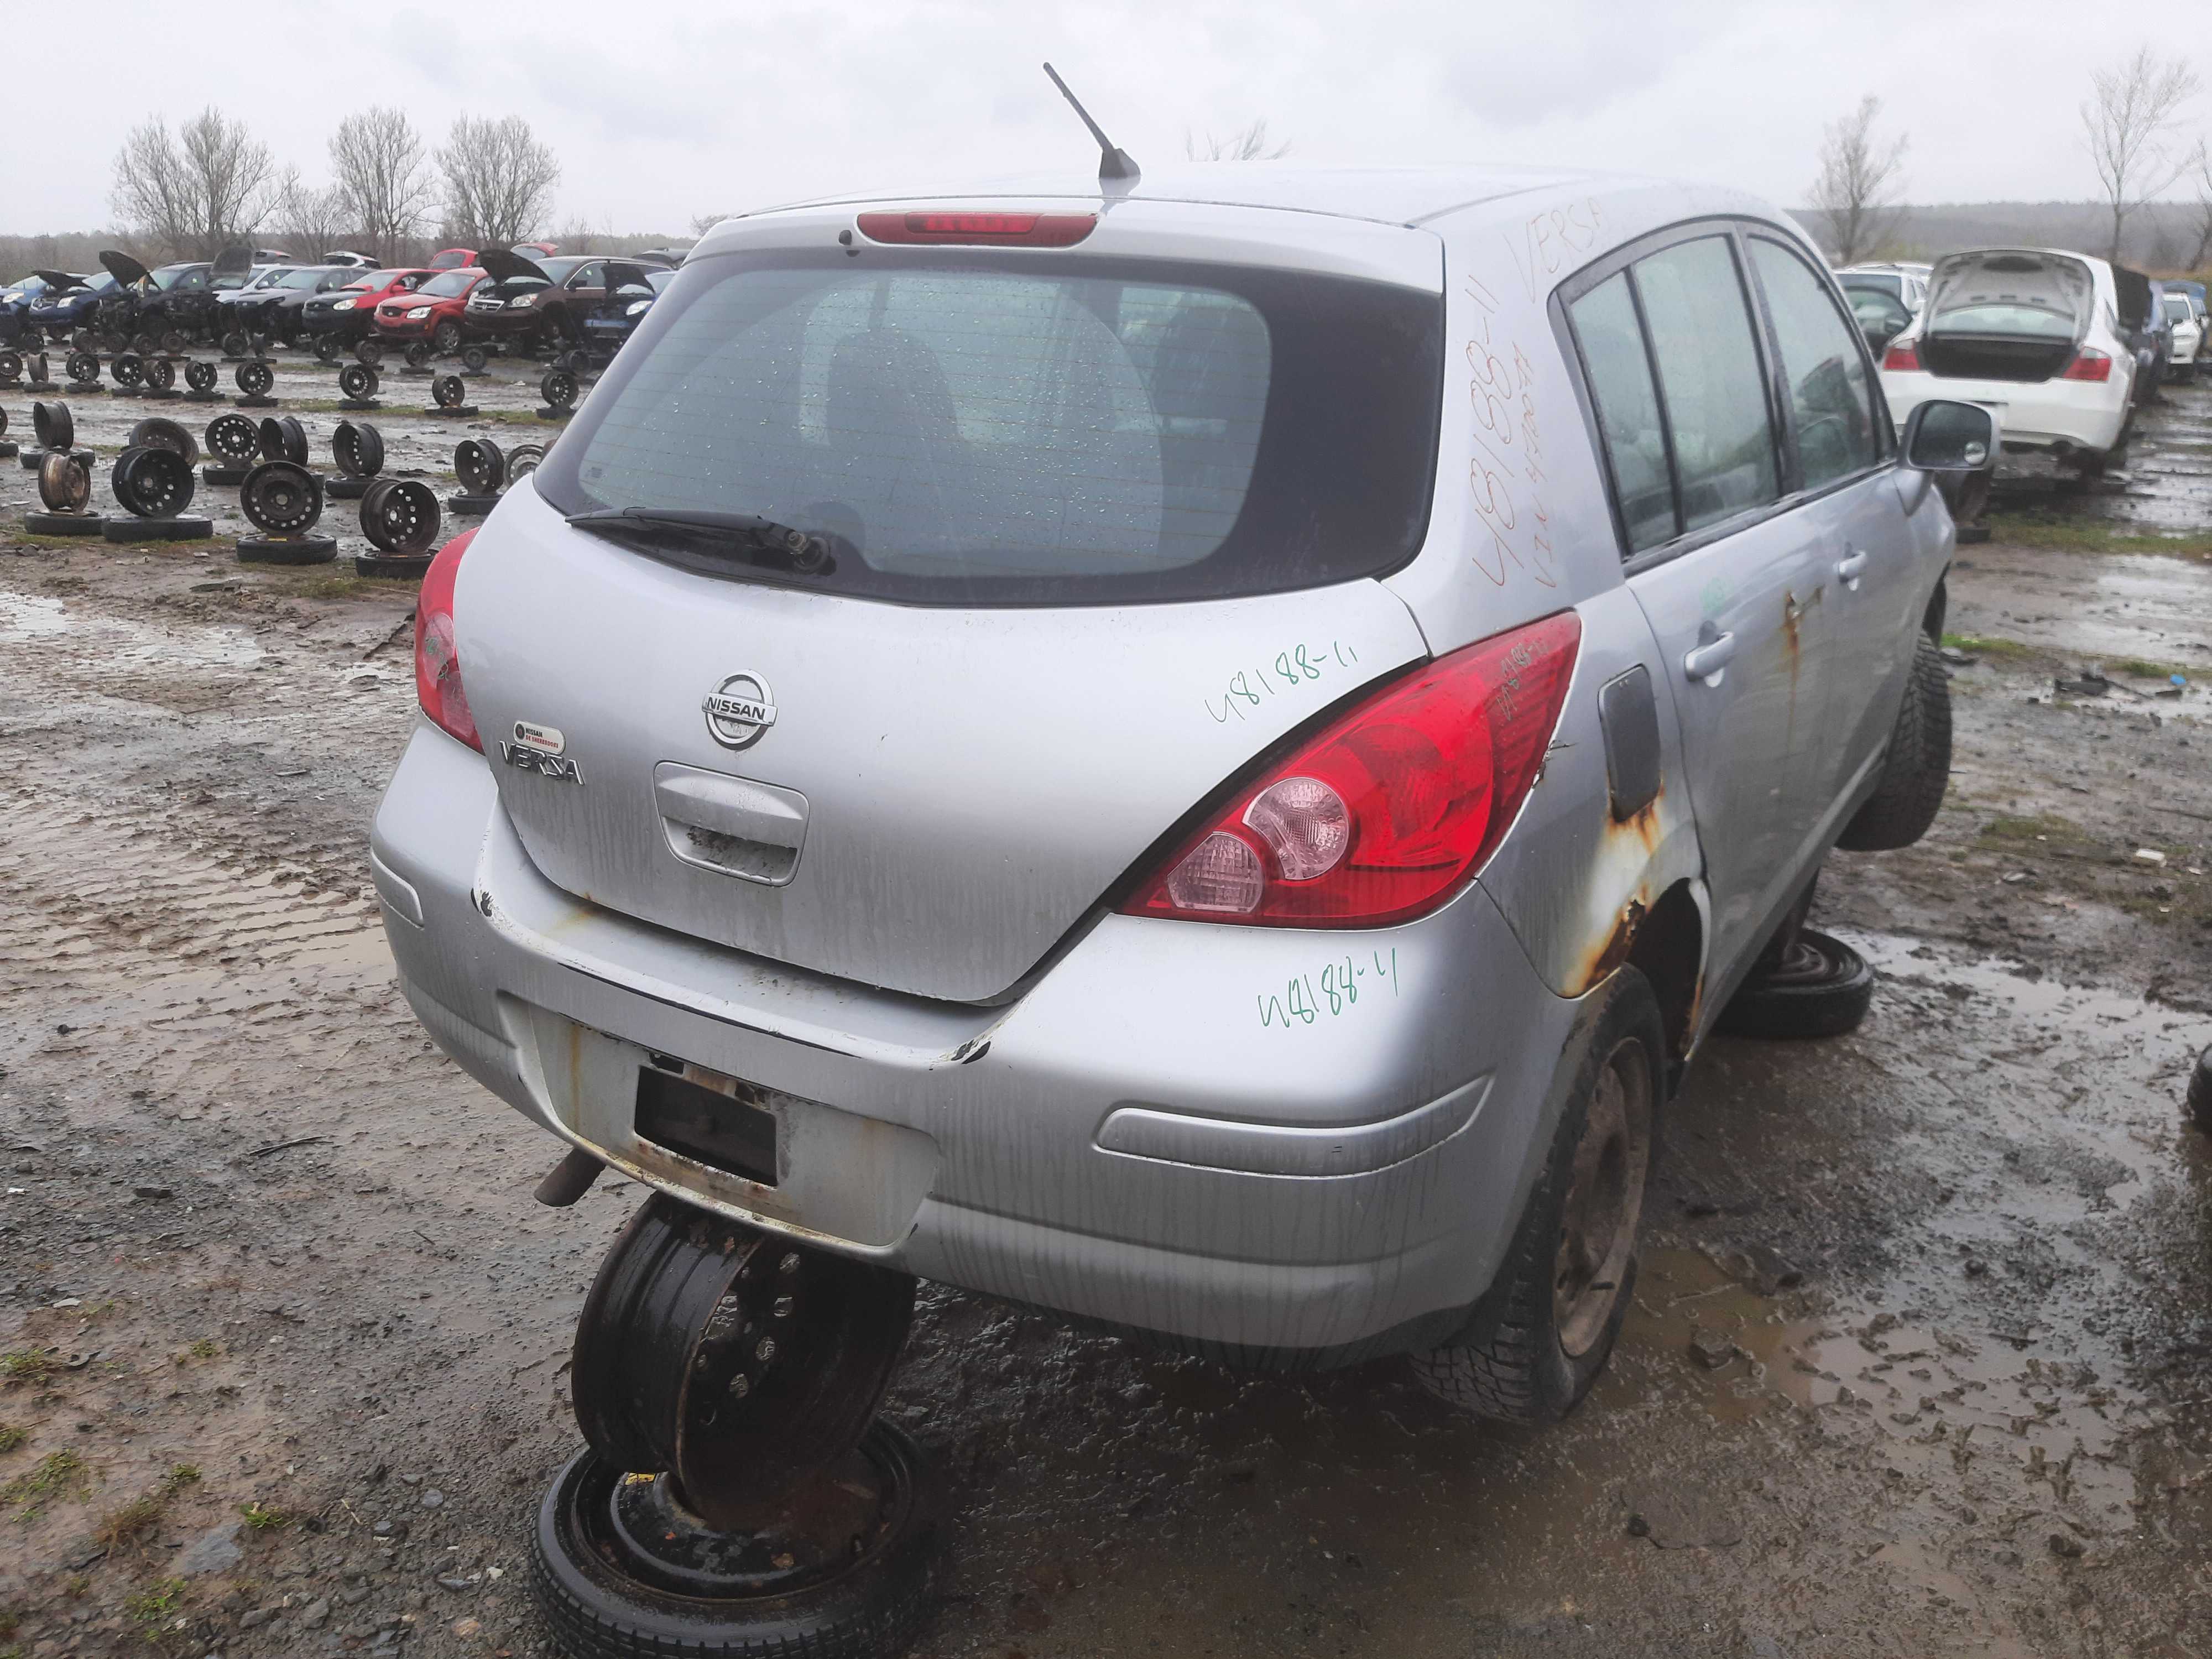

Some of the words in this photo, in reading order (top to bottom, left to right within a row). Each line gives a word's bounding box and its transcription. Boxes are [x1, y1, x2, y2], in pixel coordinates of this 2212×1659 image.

[1503, 197, 1603, 304] VERSA
[1465, 274, 1524, 587] 48188-11
[706, 696, 766, 720] NISSAN
[1204, 640, 1358, 724] 48188-11
[499, 740, 586, 786] VERSA
[525, 727, 543, 738] NISSAN
